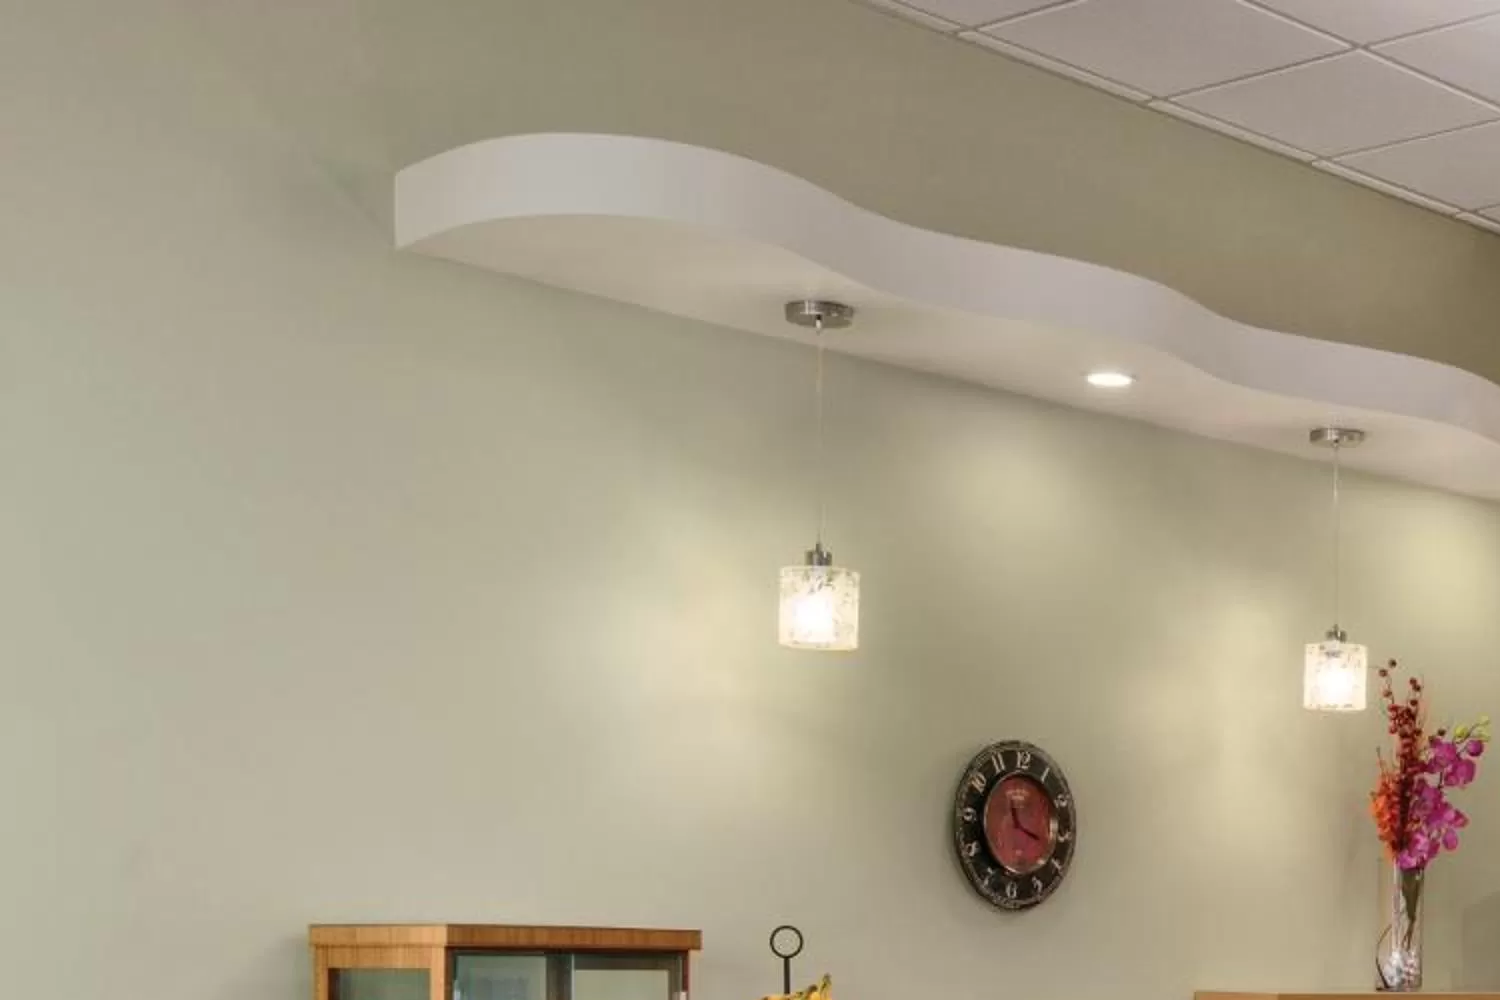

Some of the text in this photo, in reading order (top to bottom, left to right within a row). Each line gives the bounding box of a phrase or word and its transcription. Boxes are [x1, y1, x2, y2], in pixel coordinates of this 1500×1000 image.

[992, 752, 1006, 775] 11
[1016, 751, 1031, 770] 12
[1041, 767, 1051, 784] 1
